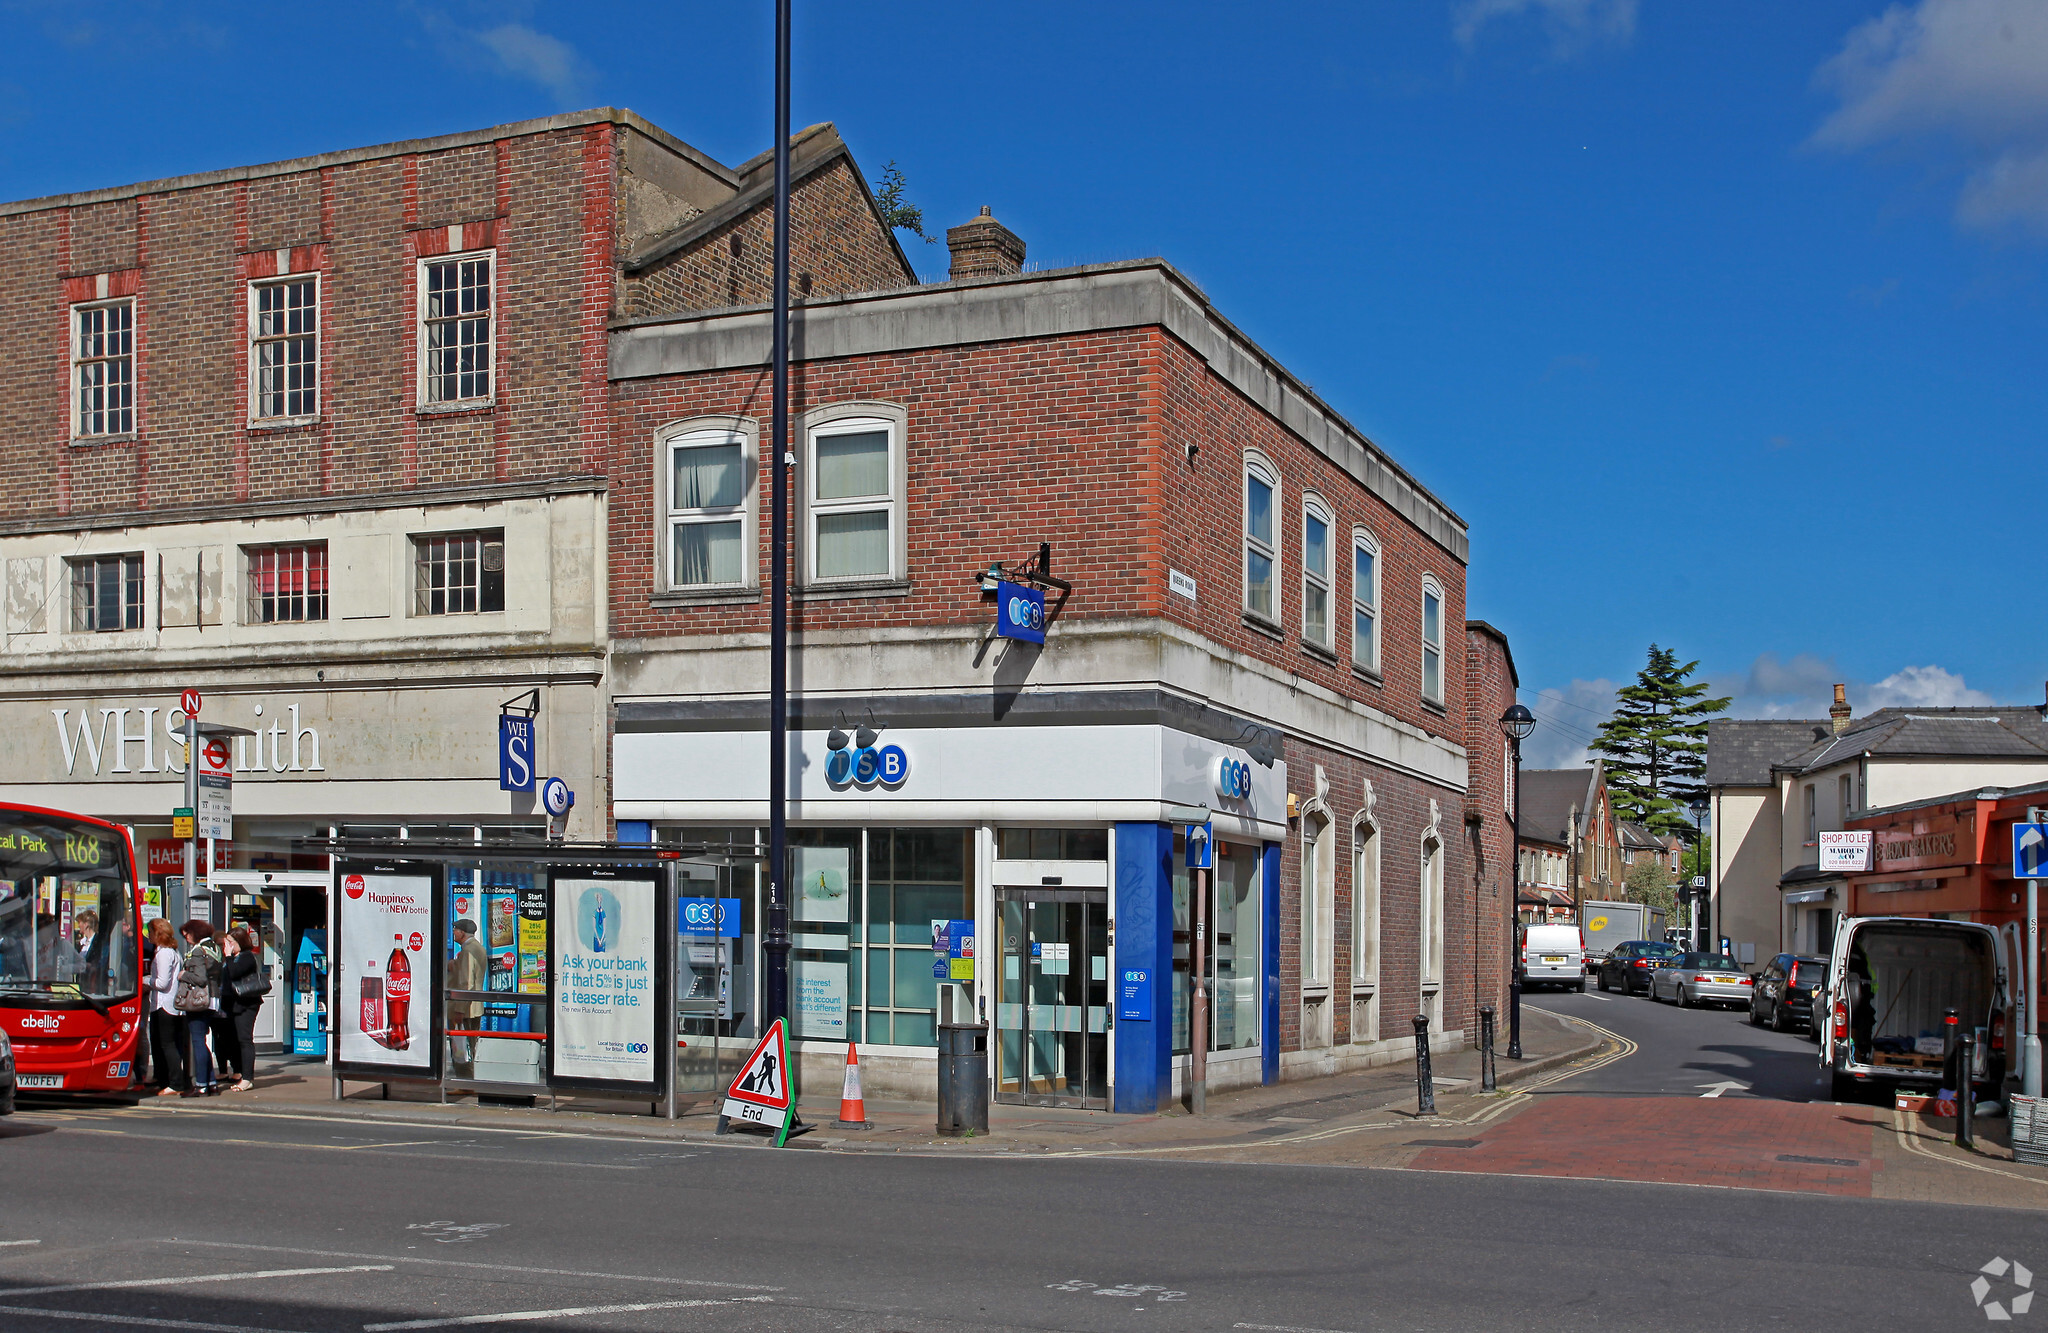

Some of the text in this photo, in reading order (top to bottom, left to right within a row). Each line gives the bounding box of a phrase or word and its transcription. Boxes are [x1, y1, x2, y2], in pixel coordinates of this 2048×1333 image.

[1013, 603, 1039, 624] TSB
[186, 693, 199, 712] N
[507, 721, 528, 736] WH
[508, 736, 530, 787] S
[835, 753, 900, 775] TSB
[1223, 766, 1249, 792] TSB
[21, 834, 48, 853] Park
[1821, 833, 1872, 844] SHOP TO LET
[1912, 834, 1955, 858] BAKERY
[65, 833, 100, 864] R68
[1829, 847, 1865, 855] MARQUIS
[150, 889, 157, 904] 2
[368, 892, 415, 905] Happiness
[520, 900, 546, 908] Collectin
[389, 905, 409, 914] NEW
[562, 954, 648, 972] Ask your bank
[562, 972, 570, 986] if
[572, 973, 594, 988] that
[614, 974, 623, 989] is
[625, 975, 648, 992] just
[805, 978, 831, 987] interest
[561, 990, 641, 1007] a teaser rate.
[813, 987, 824, 995] the
[813, 995, 841, 1004] account
[121, 1006, 136, 1014] 8539
[21, 1014, 60, 1029] abellio
[298, 1038, 313, 1047] kobo
[628, 1044, 648, 1052] TSB
[19, 1075, 58, 1086] YX10 FEV
[742, 1105, 764, 1121] End
